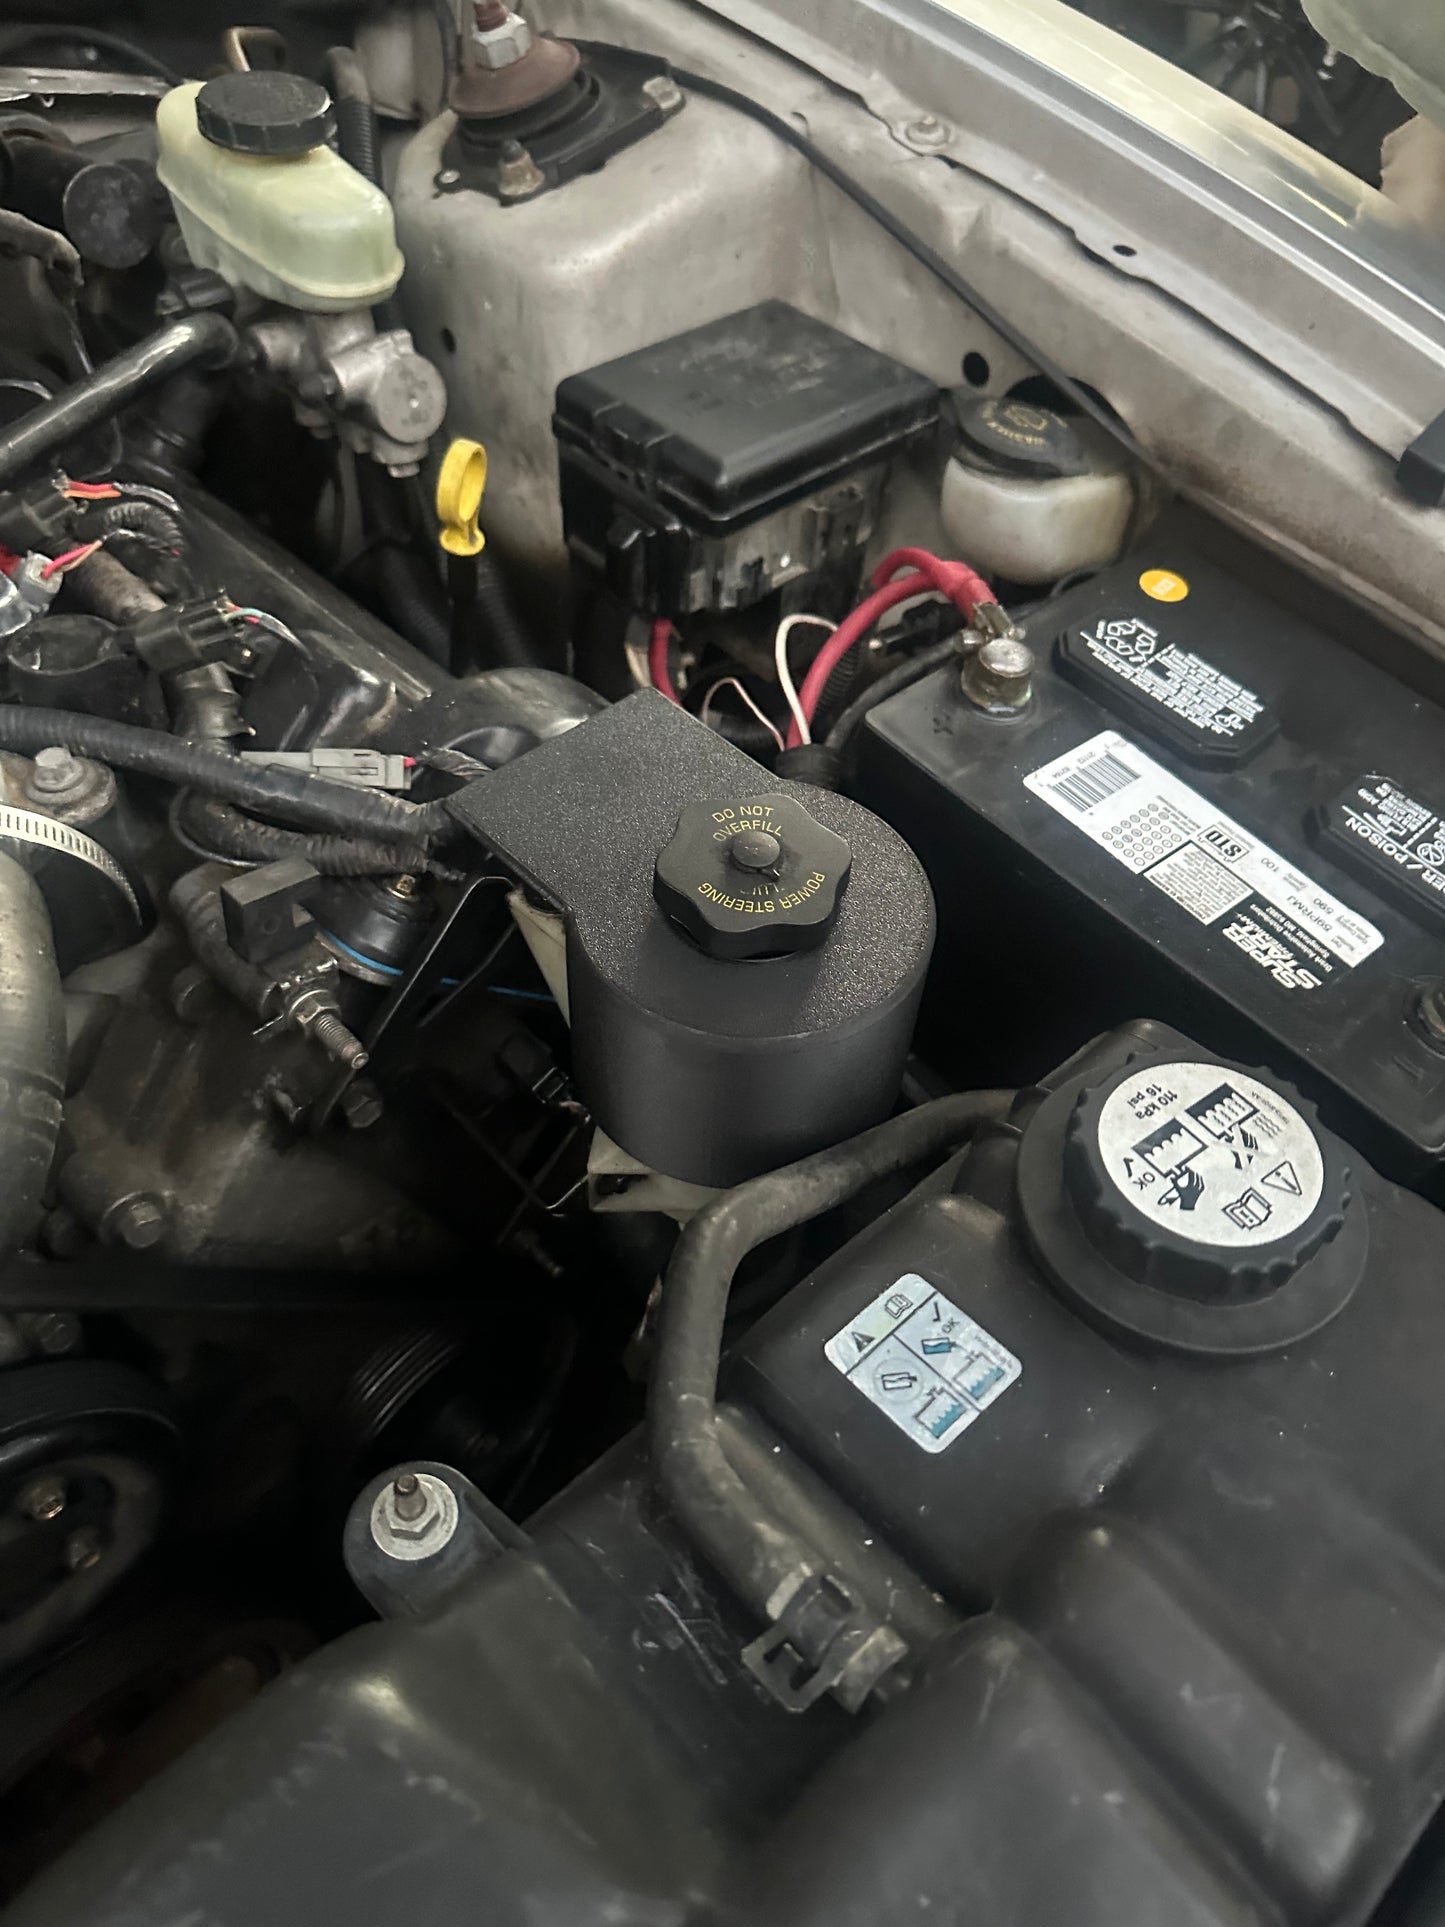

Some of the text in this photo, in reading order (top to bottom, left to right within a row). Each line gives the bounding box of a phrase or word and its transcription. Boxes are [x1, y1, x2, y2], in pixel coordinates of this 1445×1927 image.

[712, 805, 775, 823] DO NOT
[713, 820, 783, 842] OVERFILL
[1202, 827, 1243, 859] STD
[1343, 815, 1409, 864] POISON
[1259, 855, 1280, 873] 100
[698, 871, 825, 913] POWER STEERING
[1419, 868, 1444, 893] ER
[1311, 896, 1334, 915] 590
[1248, 902, 1333, 973] Ozark Automotive Distributors
[1294, 927, 1331, 959] Springfield,
[1219, 923, 1302, 990] SUPER
[1229, 922, 1323, 990] START
[1127, 1083, 1162, 1108] 16 psi
[1134, 1089, 1178, 1120] 110 kPa
[1133, 1172, 1156, 1190] OK
[942, 1318, 961, 1334] OK
